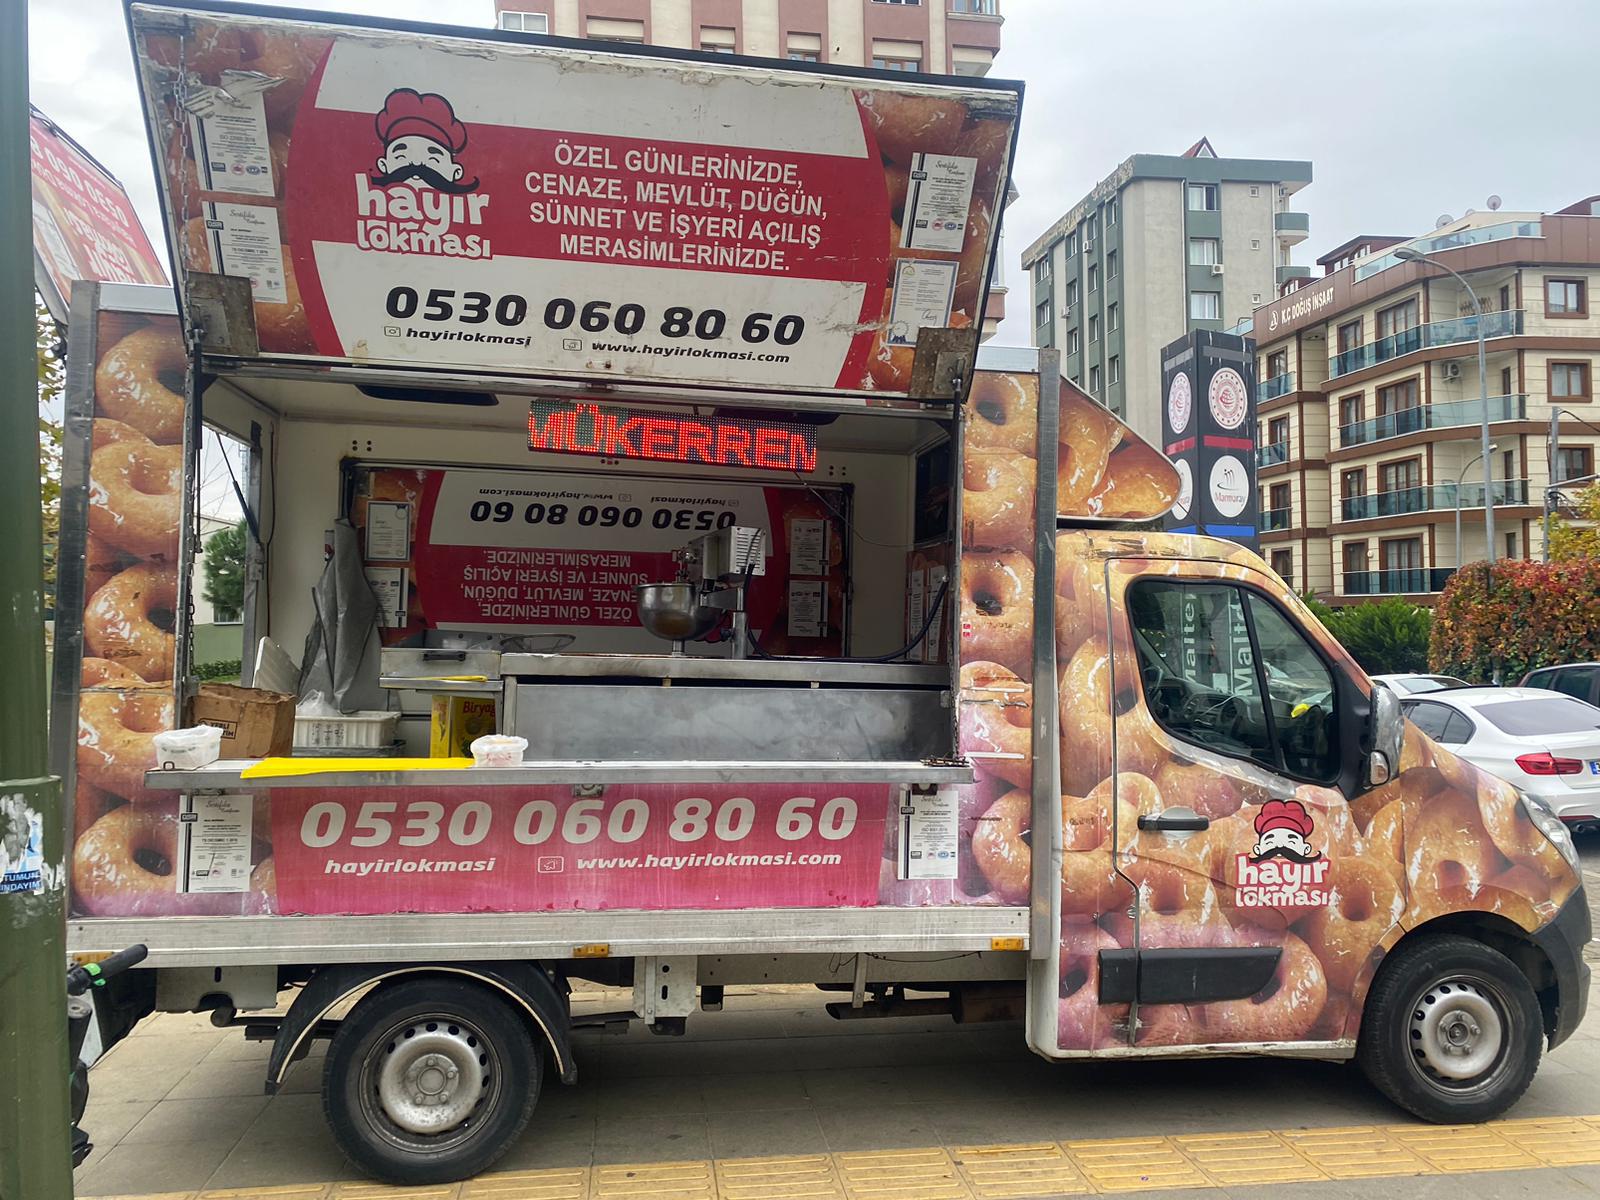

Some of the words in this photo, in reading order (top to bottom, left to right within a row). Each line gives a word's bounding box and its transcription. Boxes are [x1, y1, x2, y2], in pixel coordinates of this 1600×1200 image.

[554, 139, 618, 170] ÖZEL
[625, 147, 803, 188] GÜNLERİNİZDE,
[355, 173, 490, 236] hayır
[525, 172, 628, 204] CENAZE,
[636, 181, 732, 212] MEVLÜT,
[740, 187, 827, 220] DÜĞÜN,
[530, 199, 626, 229] SÜNNET
[632, 211, 662, 232] VE
[670, 209, 743, 239] İŞYERİ
[748, 220, 821, 249] AÇILIŞ
[560, 234, 790, 270] MERASİMLERİNİZDE.
[1312, 287, 1334, 312] İNŞAAT
[385, 286, 527, 326] 0530
[543, 298, 646, 334] 060
[660, 306, 726, 340] 80
[741, 313, 805, 346] 60
[406, 327, 531, 347] hayirlokmasi
[591, 341, 790, 363] www.hayirlokmasi.com
[470, 500, 514, 523] 60
[524, 502, 568, 525] 80
[577, 505, 643, 528] 060
[652, 508, 736, 530] 0530
[568, 571, 585, 584] VE
[589, 589, 638, 603] ENAZE,
[595, 606, 632, 623] ÖZEL
[300, 800, 492, 848] 0530
[513, 799, 650, 845] 060
[669, 797, 755, 842] 80
[775, 797, 858, 841] 60
[324, 858, 496, 876] hayirlokmasi
[577, 852, 841, 870] www.hayirlokmasi.com
[1238, 856, 1329, 892] hayır
